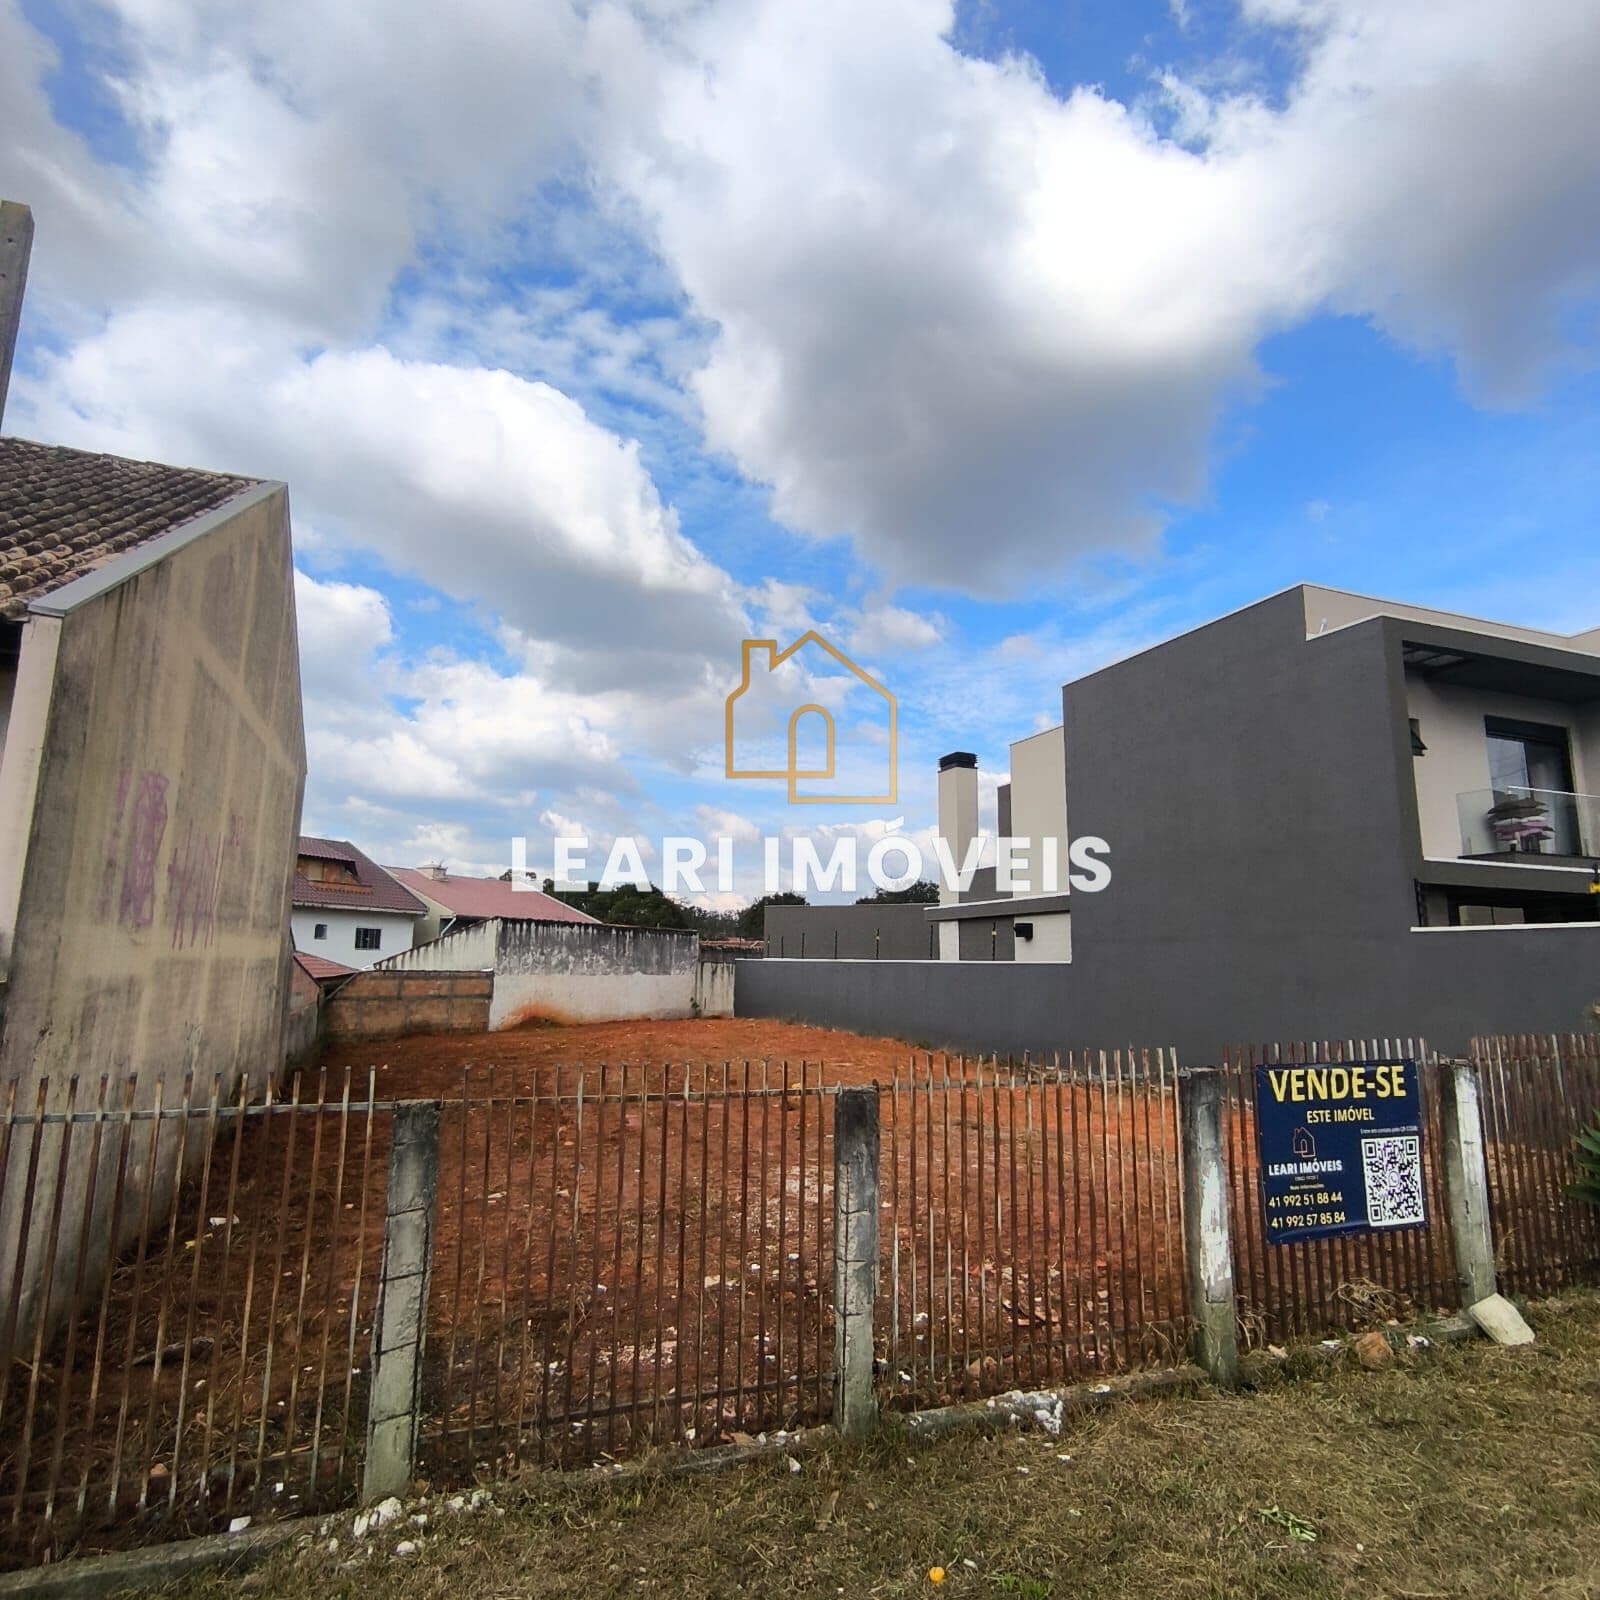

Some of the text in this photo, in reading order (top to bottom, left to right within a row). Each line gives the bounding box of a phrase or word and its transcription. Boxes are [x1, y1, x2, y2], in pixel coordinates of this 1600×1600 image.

[1268, 1065, 1407, 1102] VENDE-SE
[1306, 1105, 1375, 1124] ESTE IMÓVEL
[1268, 1157, 1343, 1176] LEARI IMÓVEIS
[1268, 1191, 1343, 1208] 41 992 51 88 44
[1271, 1211, 1346, 1229] 41 992 57 85 84
